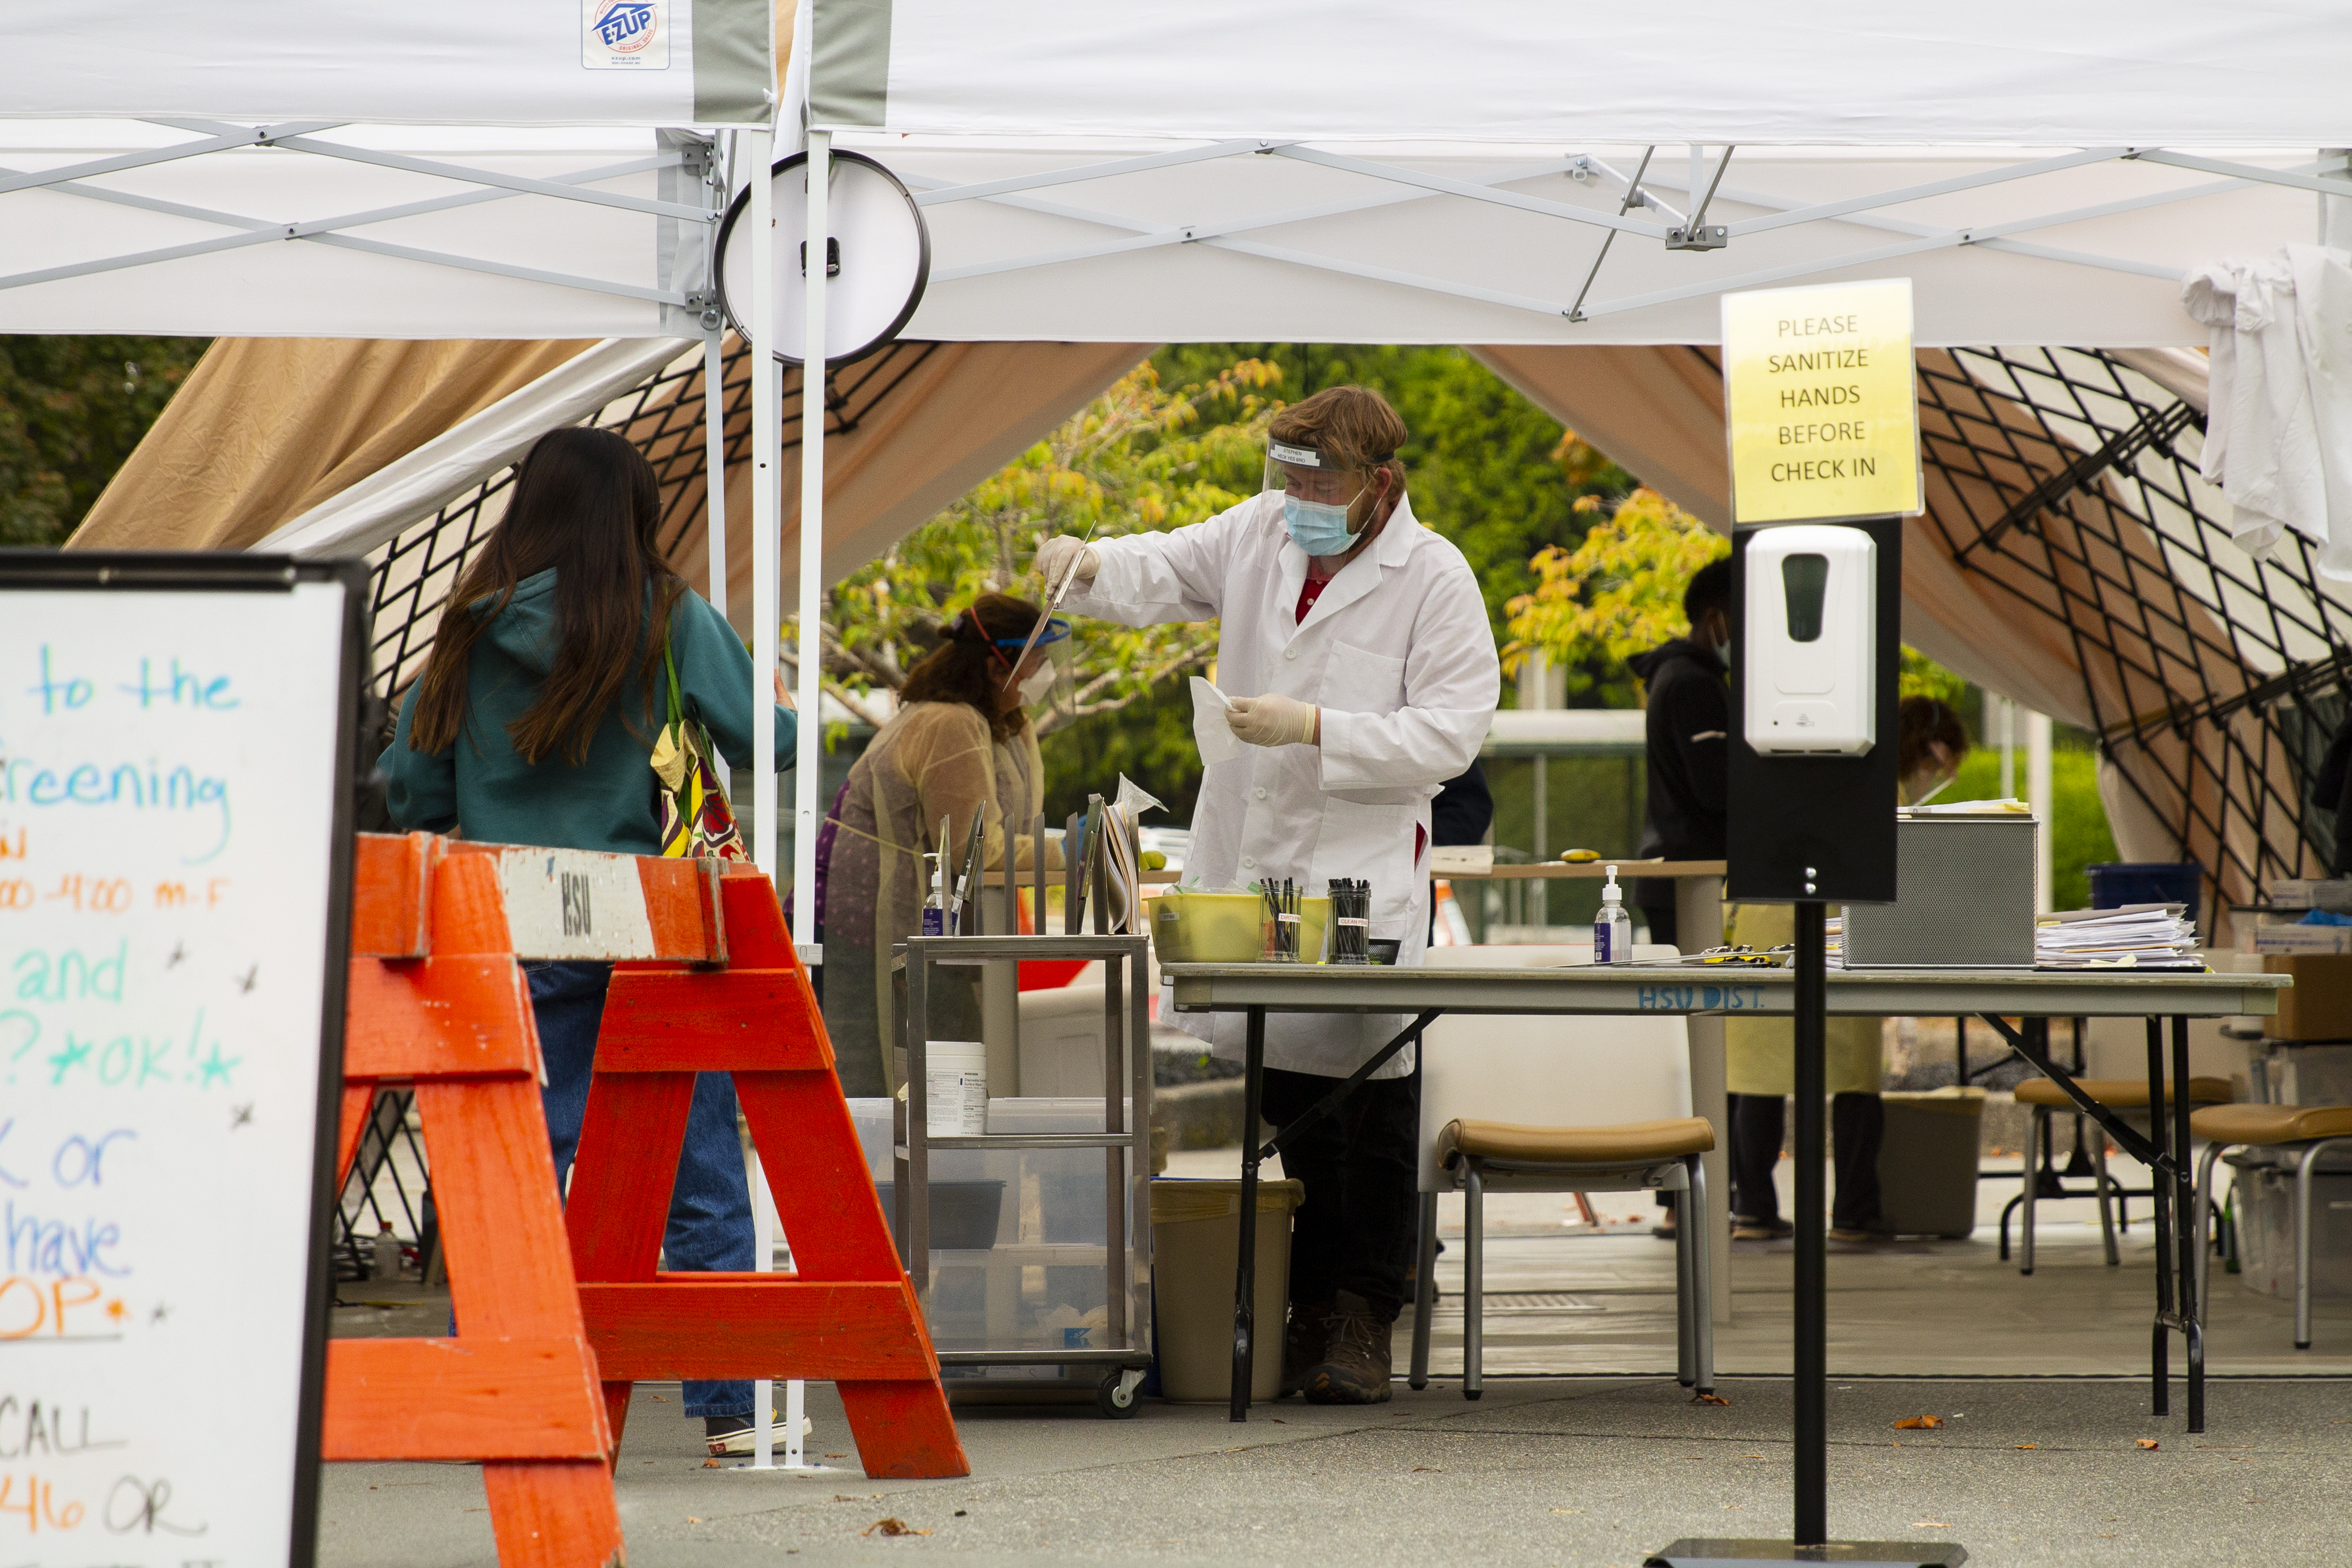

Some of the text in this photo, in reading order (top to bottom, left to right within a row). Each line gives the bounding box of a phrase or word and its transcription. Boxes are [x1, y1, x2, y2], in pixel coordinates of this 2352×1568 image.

[619, 29, 654, 51] ORIGINAL SHADE
[1779, 315, 1858, 337] PLEASE
[1769, 349, 1869, 374] SANITIZE
[1781, 385, 1861, 408] HANDS
[1779, 421, 1866, 445] BEFORE
[1771, 457, 1876, 482] CHECK IN
[28, 645, 239, 715] to the
[561, 871, 592, 936] HSU
[14, 936, 127, 1002] and
[1638, 985, 1765, 1009] HSU DIST.
[52, 1129, 138, 1188] or
[5, 1200, 134, 1279] have
[102, 1475, 208, 1537] OR
